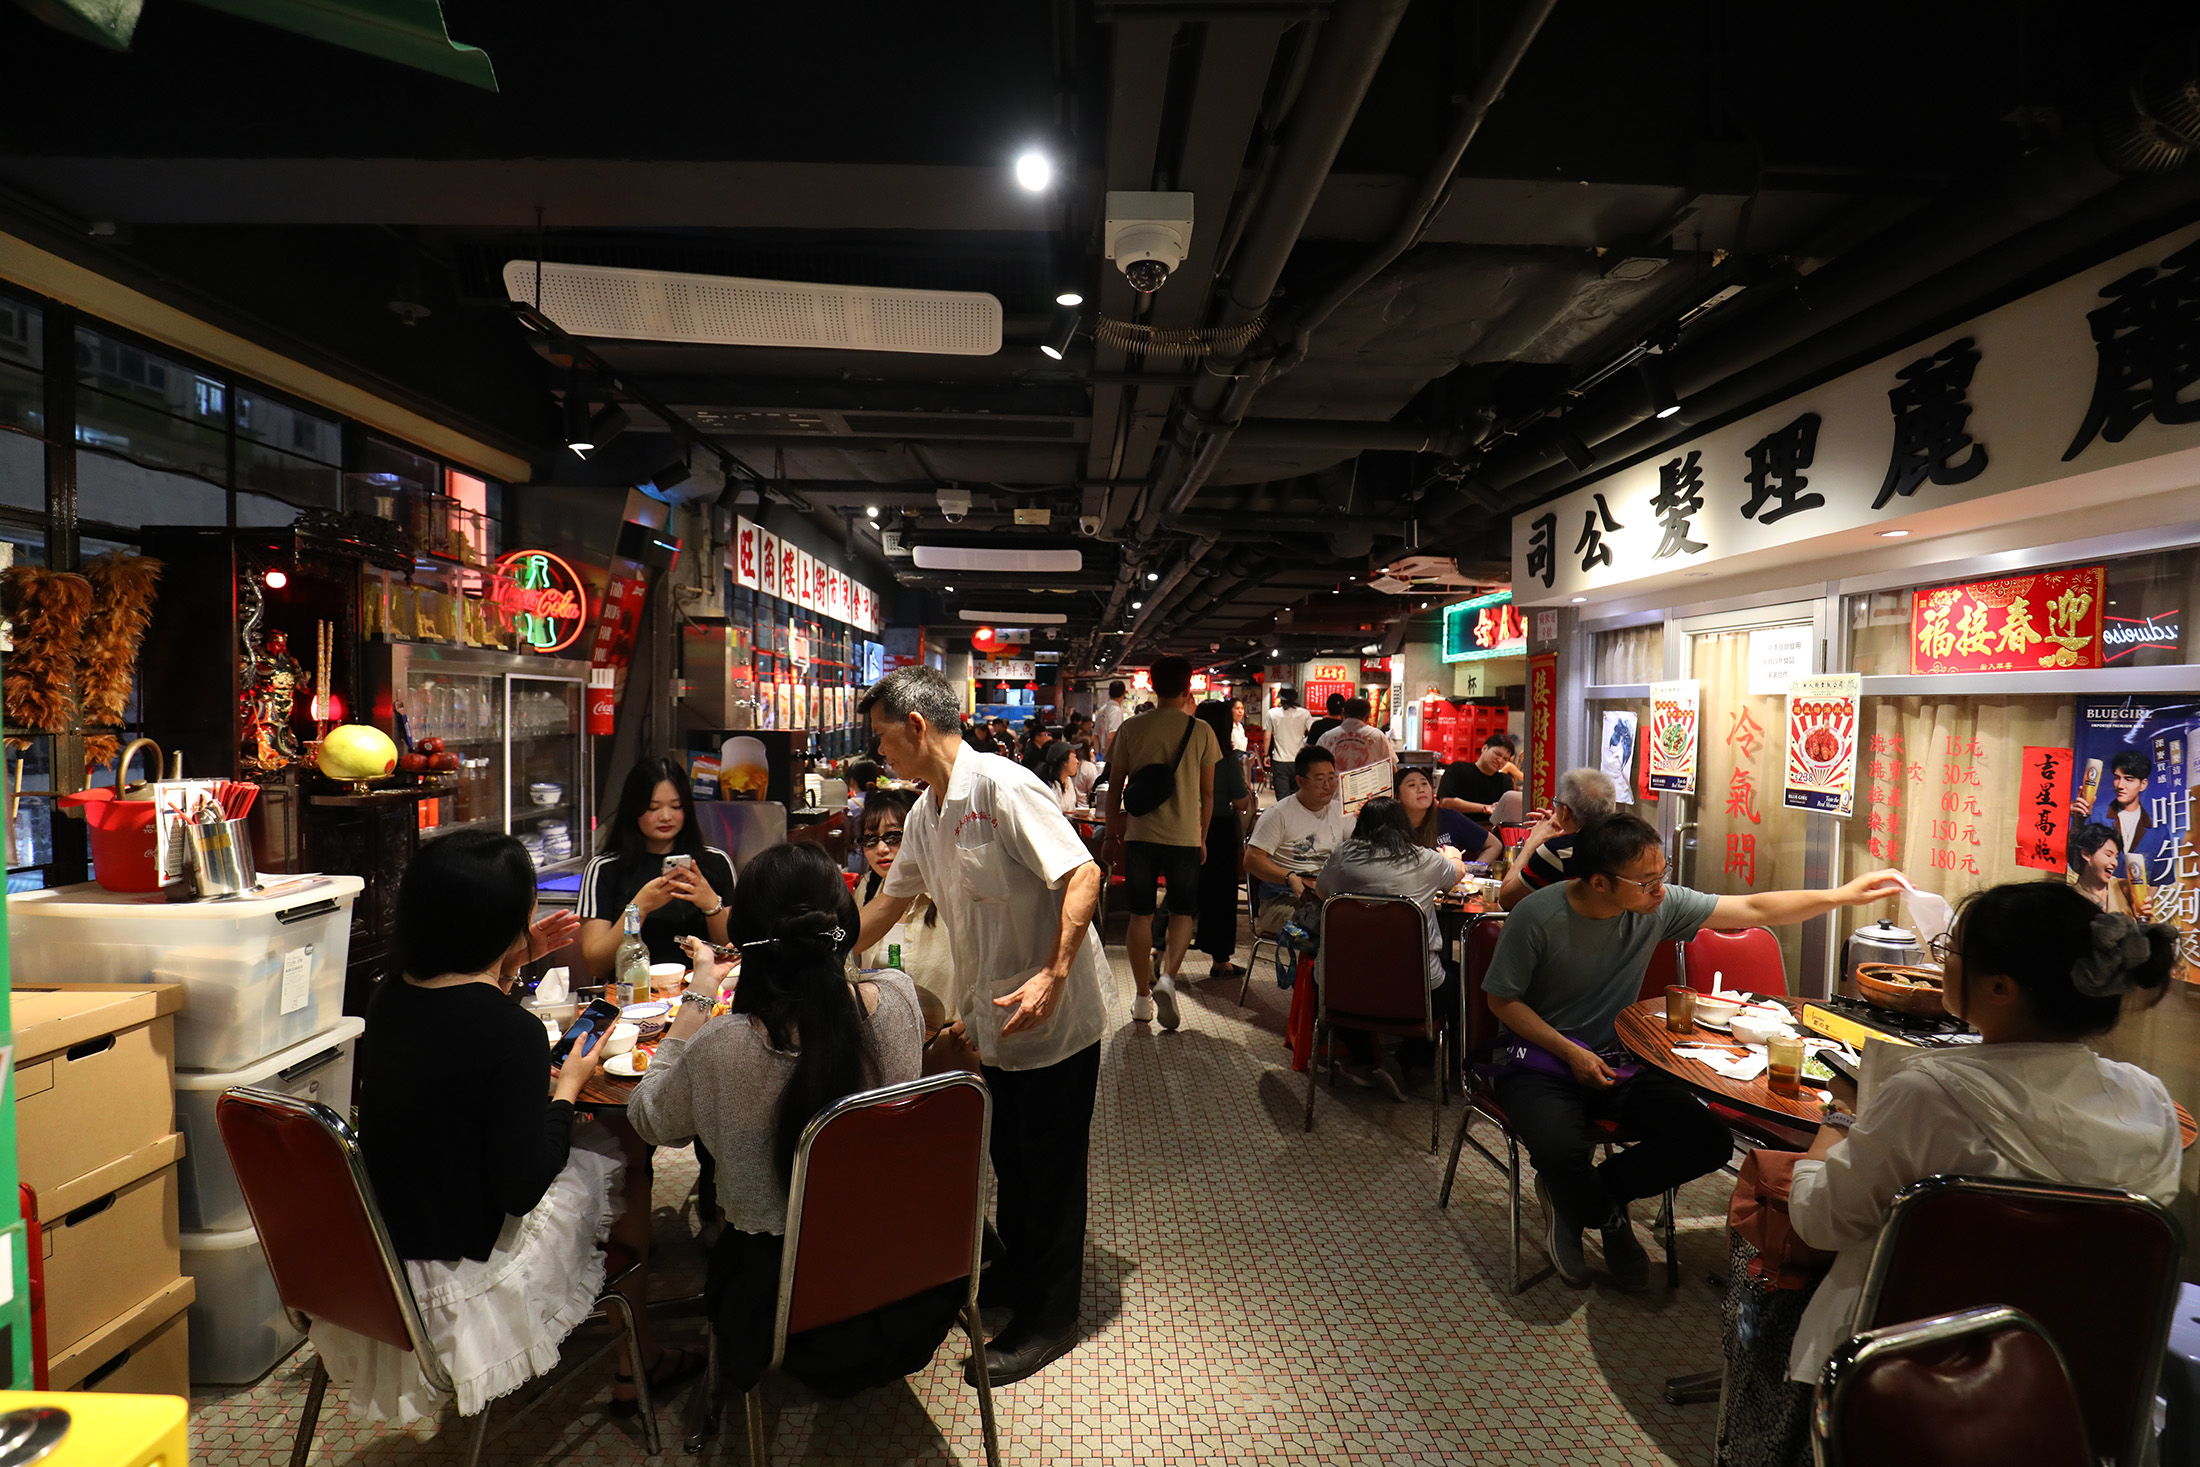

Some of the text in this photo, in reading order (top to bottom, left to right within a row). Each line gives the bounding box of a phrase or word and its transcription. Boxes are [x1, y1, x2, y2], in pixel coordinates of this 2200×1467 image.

[2087, 709, 2118, 718] BLUE
[1869, 733, 1983, 757] 洗吹 15元
[1942, 764, 1981, 786] 30元
[1725, 705, 1763, 887] 冷氣開
[1867, 784, 1982, 816] 拉直 60元
[2031, 754, 2059, 864] 吉星高照
[1931, 819, 1981, 846] 150元
[1867, 837, 1980, 875] 電髮 180元
